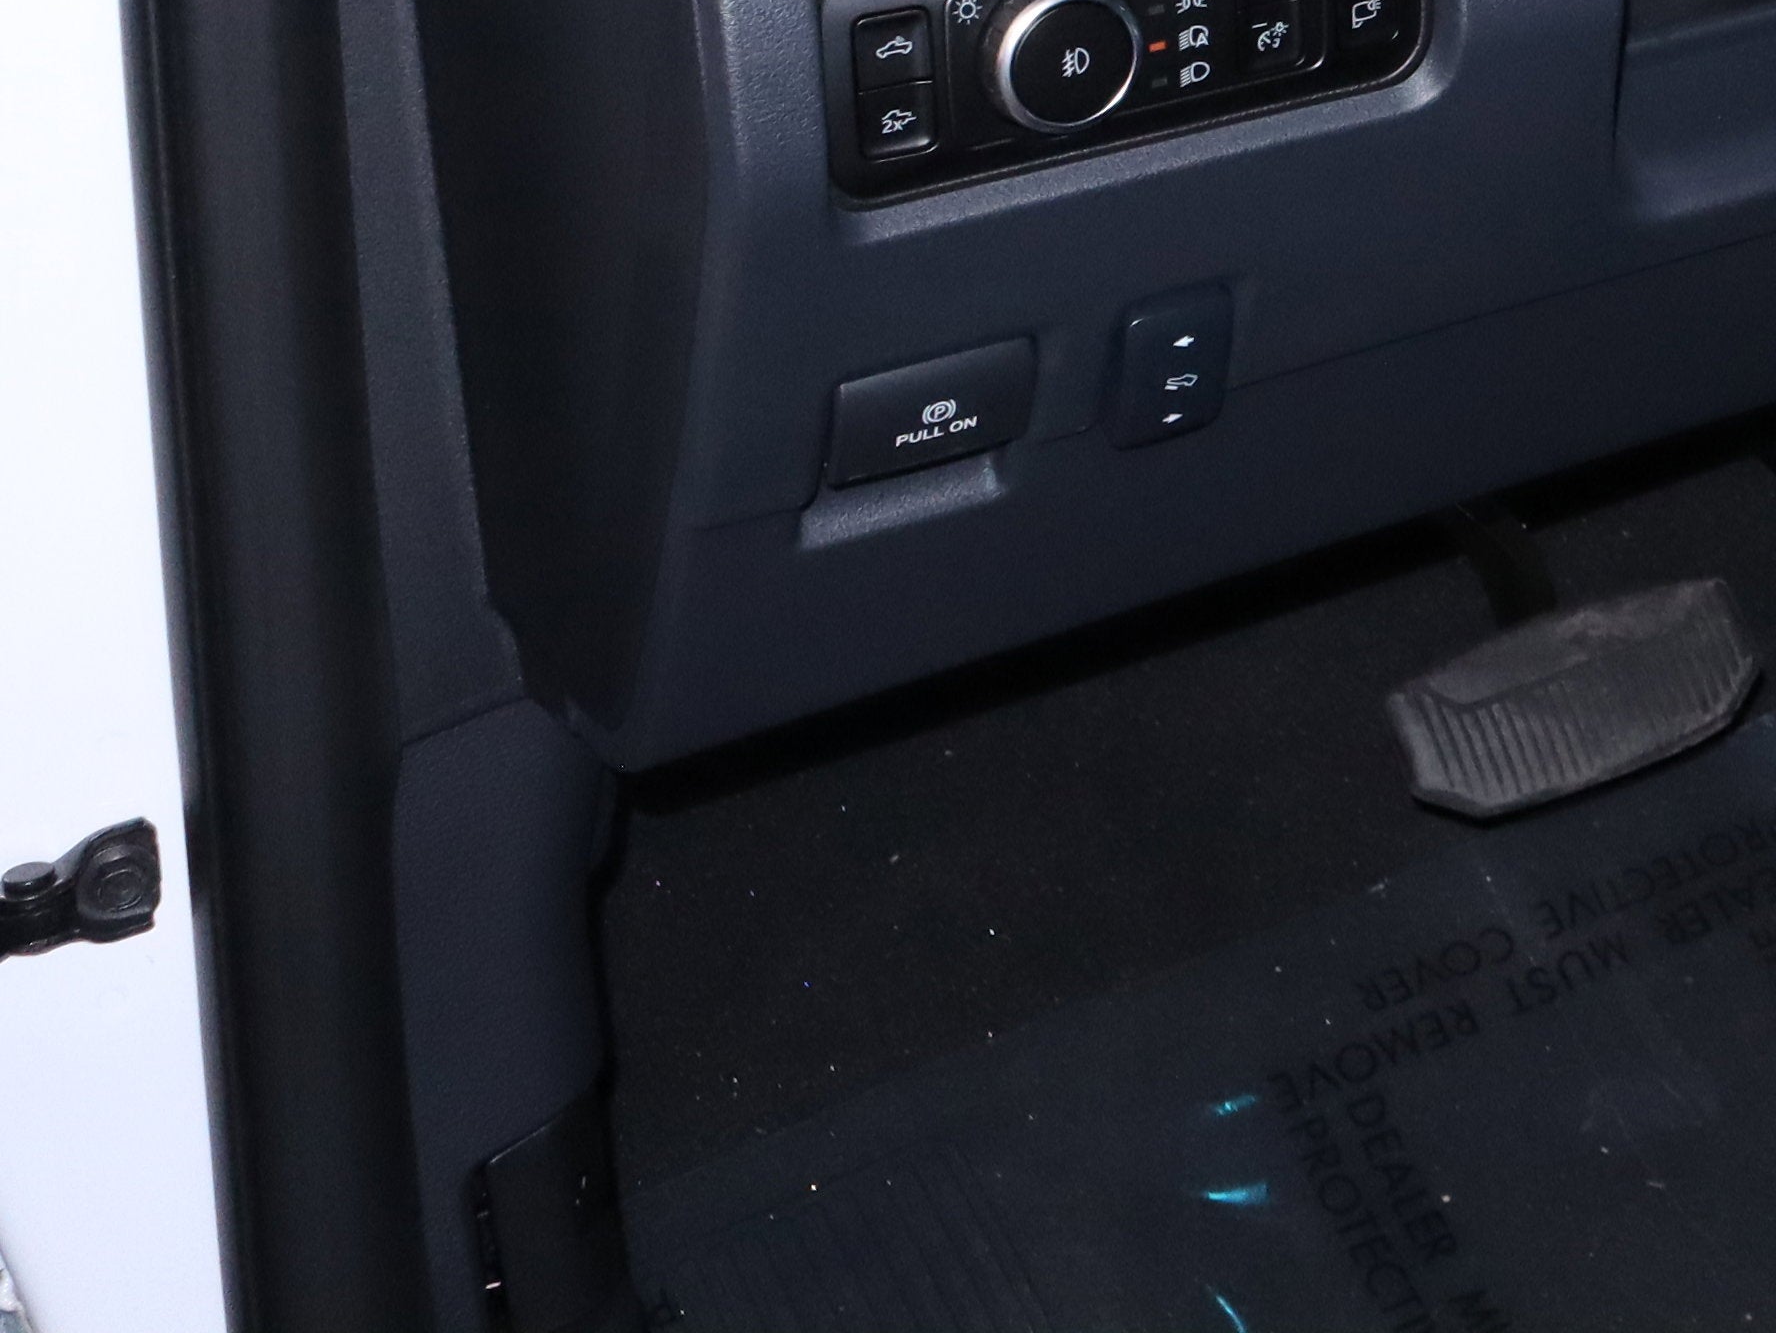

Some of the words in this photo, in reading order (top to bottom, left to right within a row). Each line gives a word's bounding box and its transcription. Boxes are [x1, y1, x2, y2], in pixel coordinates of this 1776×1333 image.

[895, 424, 945, 448] PULL
[949, 414, 979, 435] ON
[1353, 925, 1515, 1012] COVER
[1503, 931, 1631, 1017] MUST
[1266, 998, 1482, 1114] REMOVE
[1347, 1090, 1458, 1267] DEALER
